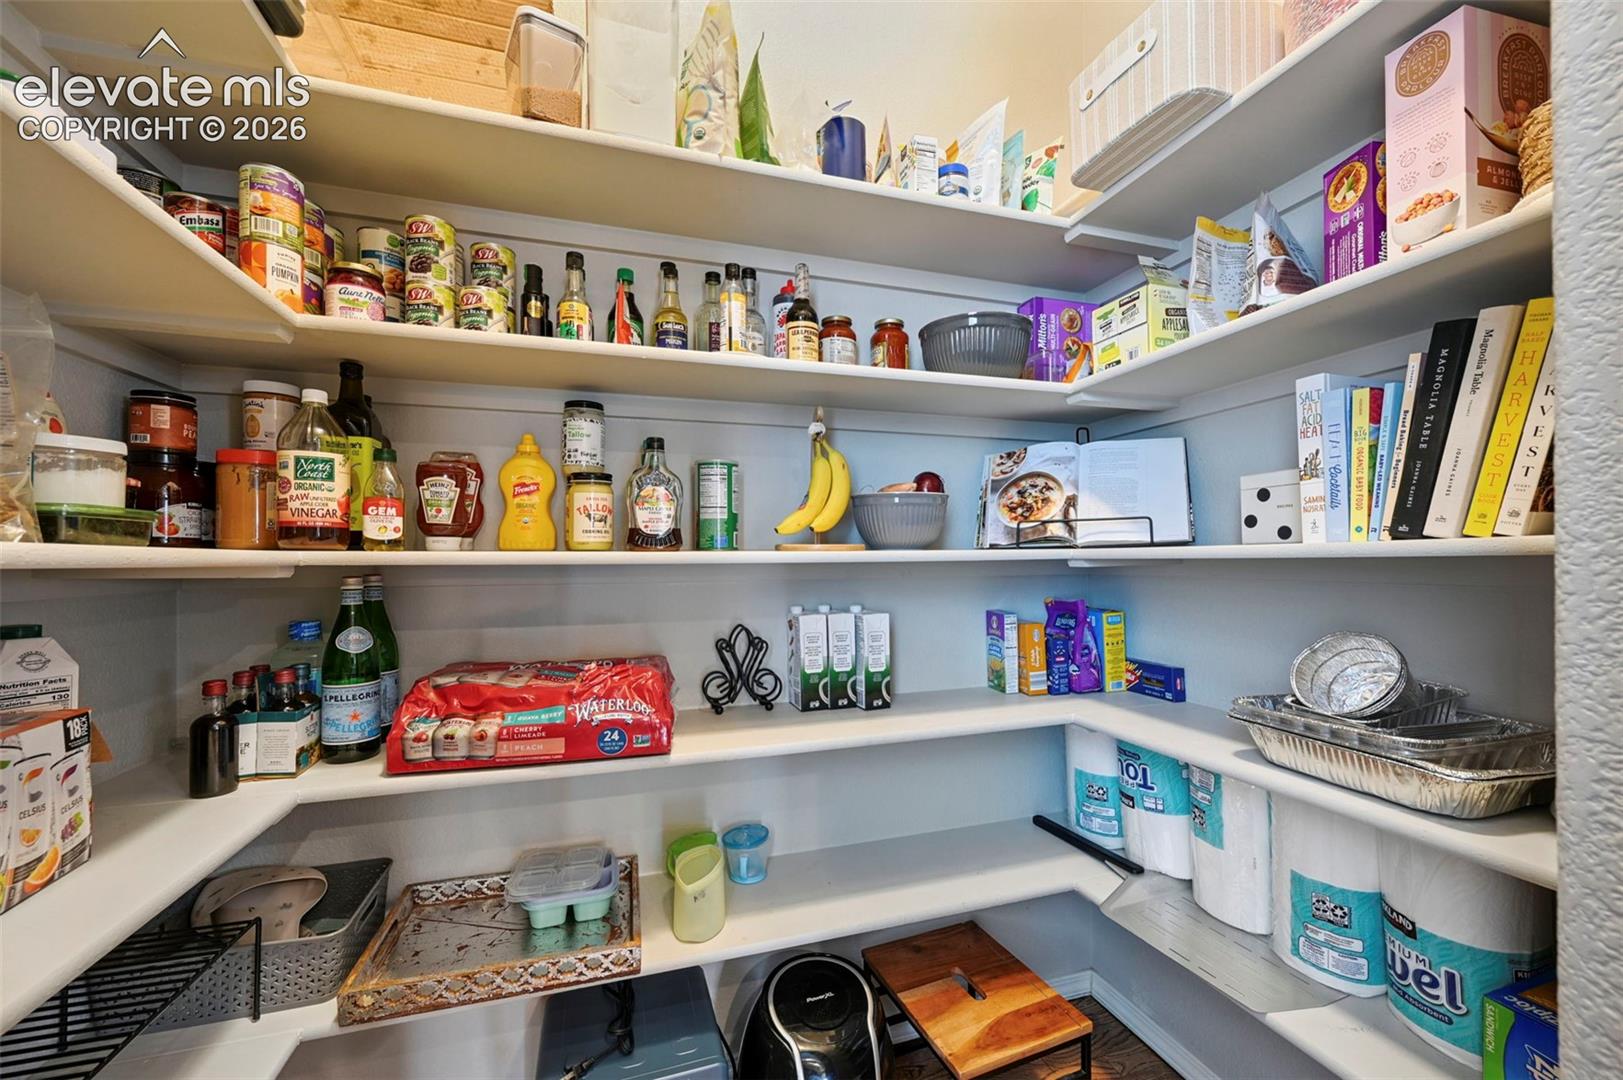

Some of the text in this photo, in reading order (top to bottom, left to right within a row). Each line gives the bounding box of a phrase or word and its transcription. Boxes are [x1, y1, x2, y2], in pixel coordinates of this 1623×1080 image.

[179, 215, 220, 227] Embasa
[271, 265, 299, 283] PUMPKIN
[338, 286, 363, 298] Aunt
[1469, 328, 1494, 395] Magnolia Table
[1298, 389, 1322, 404] SALT
[1419, 347, 1449, 449] MAGNOLIA TABLE
[1302, 402, 1319, 415] FAT
[1301, 413, 1323, 426] ACID
[1399, 410, 1409, 428] Bread
[1487, 350, 1538, 488] HARVEST
[1300, 424, 1323, 439] HEAT
[1521, 384, 1556, 478] RVEST
[297, 459, 333, 471] North
[297, 468, 329, 478] Coast
[1355, 447, 1365, 511] ORGANIC BABY FOOD
[293, 482, 325, 491] ORGANIC
[1328, 463, 1342, 511] Cocktails
[289, 493, 310, 502] RAW
[290, 507, 338, 519] VINEGAR
[367, 506, 397, 516] GEM
[0, 677, 67, 691] Nutrition Facts
[0, 700, 31, 708] Calories
[51, 693, 70, 701] 130
[567, 695, 656, 727] WATERLOO
[66, 715, 89, 740] 18 PACK
[603, 730, 620, 741] 24
[18, 802, 47, 820] CELSIUS
[60, 794, 84, 815] CELSIUS
[1404, 993, 1450, 1024] Absorbent
[1486, 1003, 1496, 1053] SANDWICH
